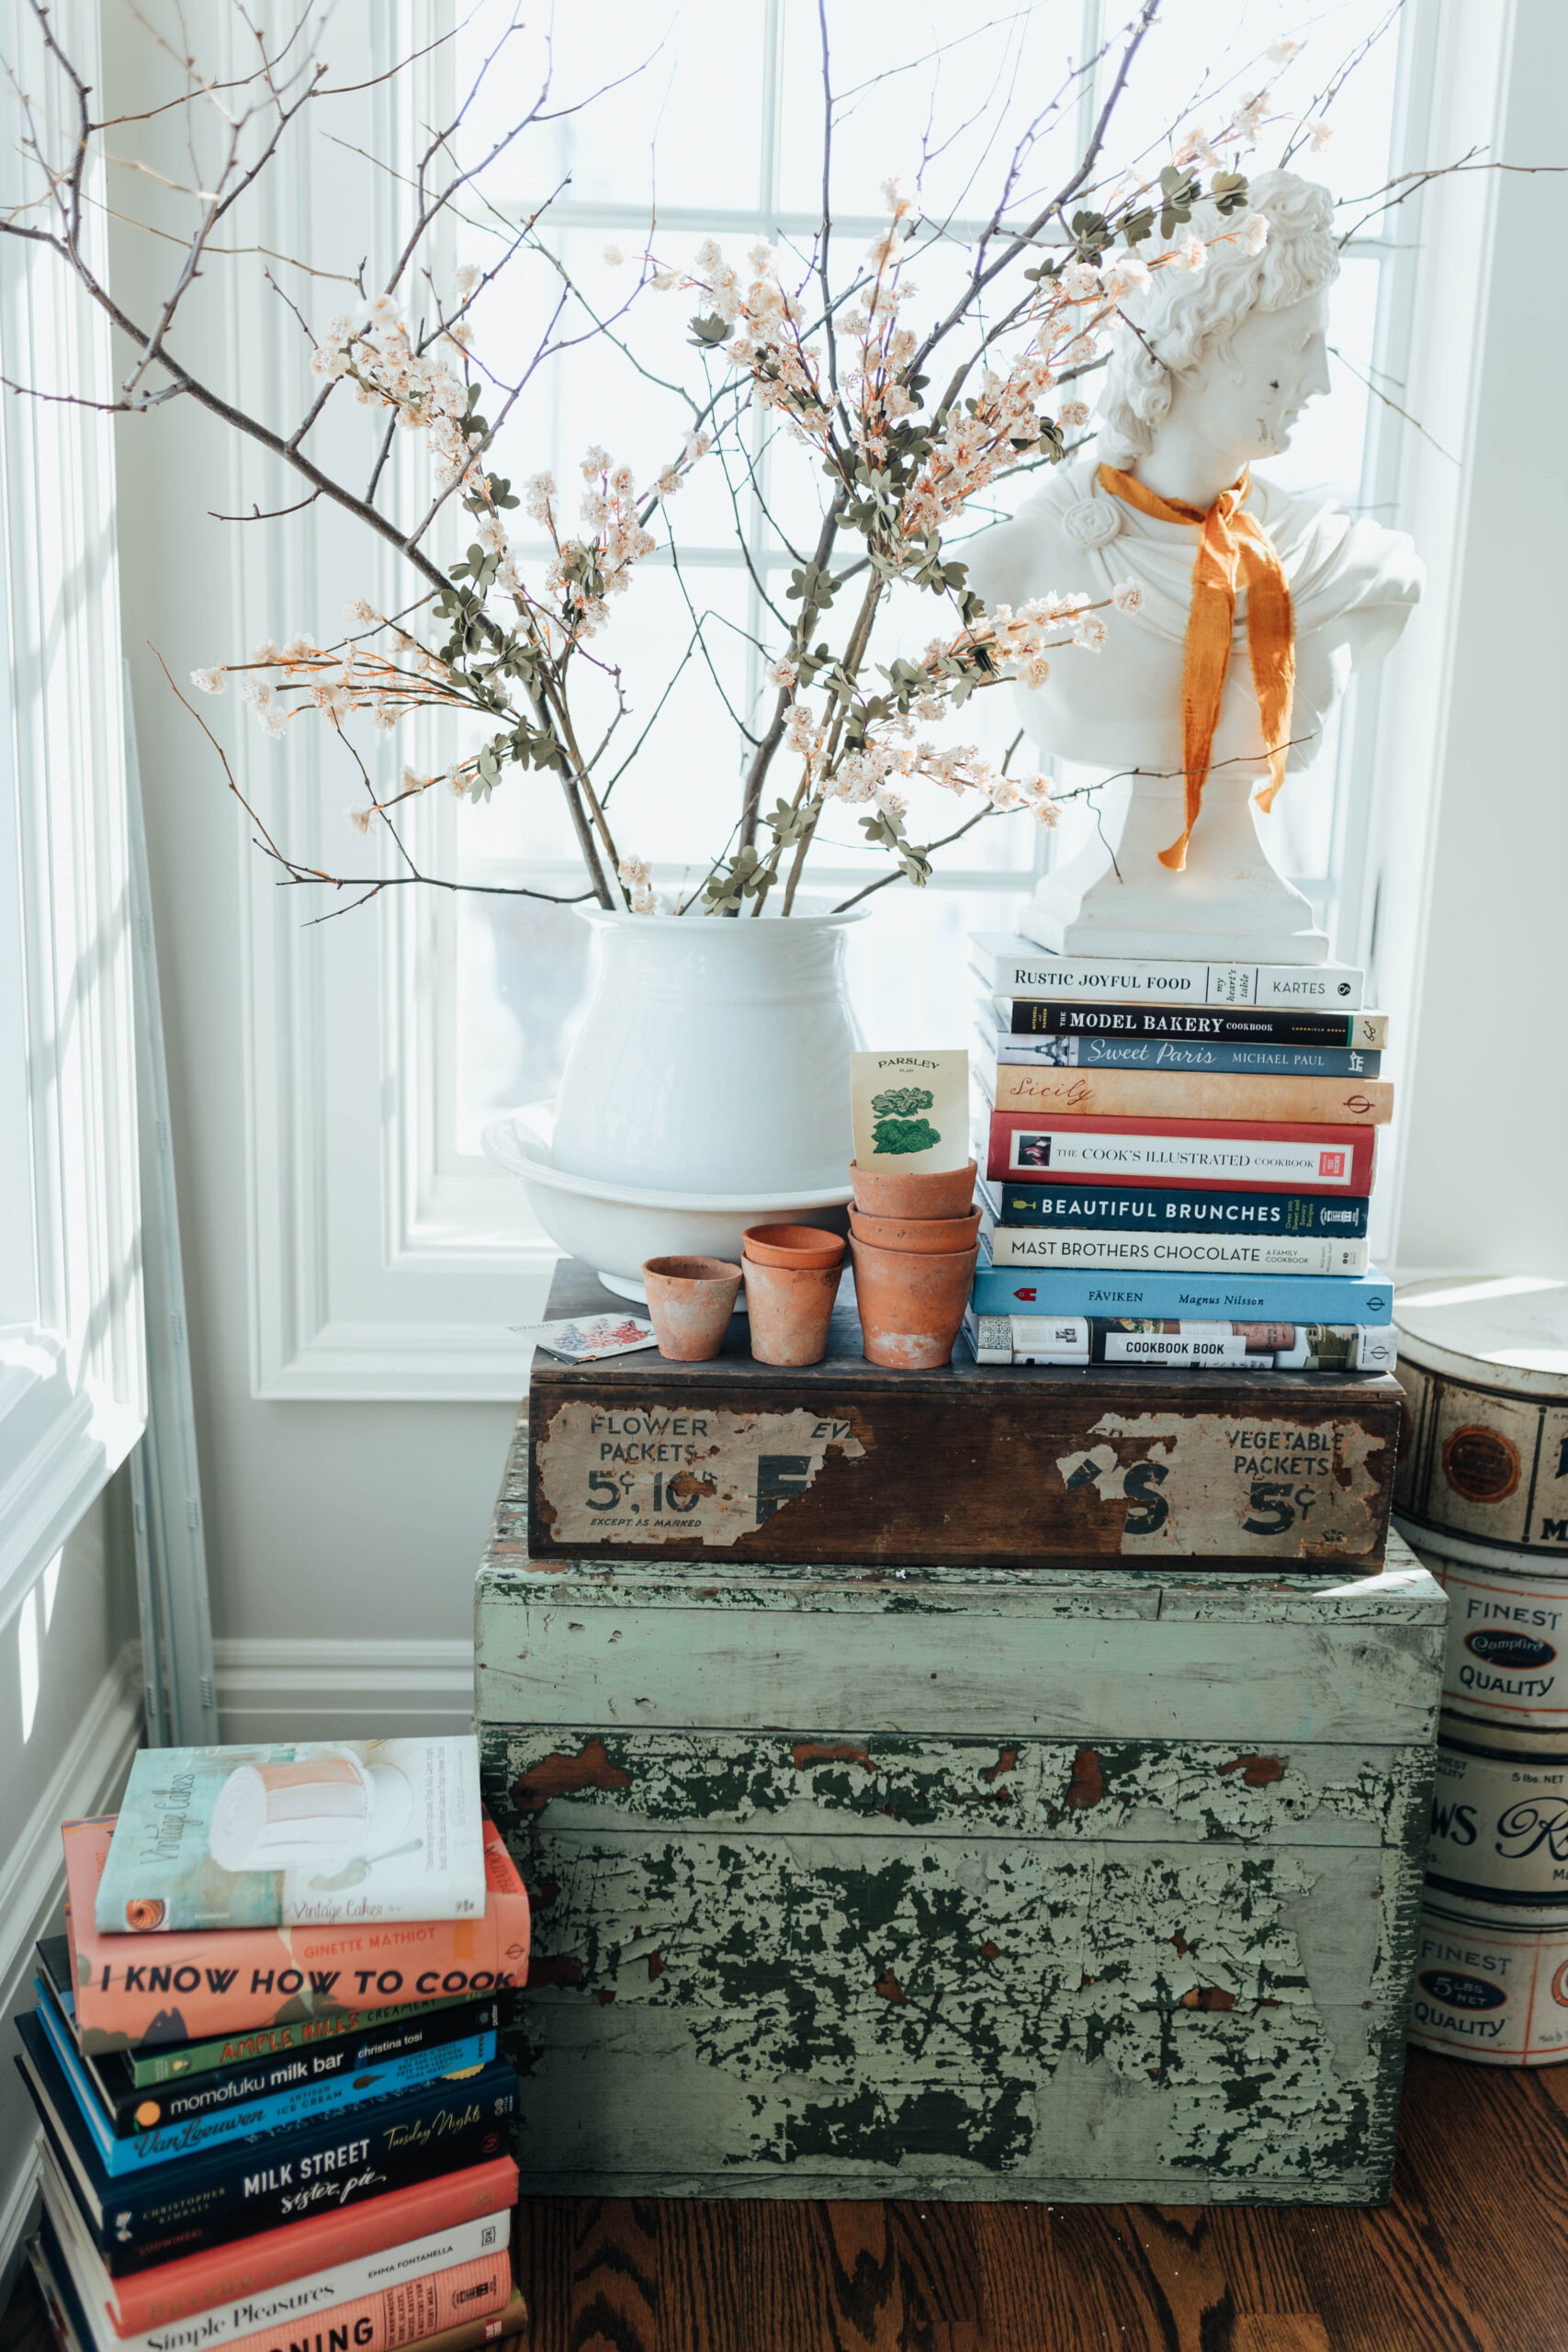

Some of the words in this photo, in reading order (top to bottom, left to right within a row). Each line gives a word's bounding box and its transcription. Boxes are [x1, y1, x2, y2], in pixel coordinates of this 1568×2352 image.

[1014, 969, 1074, 986] RUSTIC
[1078, 974, 1141, 989] JOYFUL
[1147, 977, 1191, 990] FOOD
[1216, 978, 1226, 992] my
[1226, 969, 1236, 1001] heart's
[1240, 974, 1249, 998] table
[1273, 981, 1325, 994] KARTES
[1070, 1012, 1136, 1030] MODEL
[1143, 1015, 1224, 1034] BAKERY
[1226, 1022, 1273, 1032] COOKBOOK
[877, 1057, 941, 1069] PARSLEY
[1087, 1038, 1150, 1062] Sweet
[1156, 1042, 1217, 1065] Paris
[1232, 1052, 1290, 1065] MICHAEL
[1294, 1055, 1325, 1066] PAUL
[1010, 1076, 1096, 1106] Sicily
[1056, 1148, 1078, 1158] THE
[1081, 1148, 1142, 1162] COOK'S
[1145, 1150, 1250, 1167] ILLUSTRATED
[1254, 1158, 1315, 1169] COOKBOOK
[1042, 1199, 1156, 1217] BEAUTIFUL
[1165, 1203, 1281, 1222] BRUNCHES
[1011, 1241, 1057, 1255] MAST
[1061, 1242, 1149, 1258] BROTHERS
[1154, 1245, 1260, 1261] CHOCOLATE
[1266, 1256, 1309, 1264] COOKBOOK
[1089, 1290, 1144, 1302] FÄVIKEN
[1178, 1294, 1220, 1306] Magnus
[1224, 1295, 1264, 1306] Nilsson
[1125, 1341, 1189, 1354] COOKBOOK
[1193, 1343, 1225, 1355] BOOK
[591, 1416, 708, 1438] FLOWER
[600, 1442, 695, 1464] PACKETS
[1234, 1455, 1329, 1476] PACKETS
[1241, 1482, 1316, 1536] 5¢
[591, 1518, 632, 1527] EXCEPT
[637, 1519, 650, 1527] AS
[654, 1519, 703, 1528] MARKED
[1467, 1598, 1562, 1631] FINEST
[1472, 1635, 1545, 1653] Campfire
[1459, 1665, 1555, 1698] QUALITY
[1511, 1772, 1521, 1782] 5
[1543, 1774, 1564, 1784] NET
[152, 1772, 196, 1811] Cakes
[293, 1897, 343, 1924] Vintage
[345, 1896, 383, 1917] Cakes
[303, 1938, 363, 1960] GINETTE
[369, 1927, 436, 1950] MATHIOT
[1421, 1939, 1513, 1976] FINEST
[100, 1964, 111, 1992] I
[125, 1965, 240, 1995] KNOW
[250, 1968, 341, 1995] HOW
[354, 1970, 403, 1996] TO
[415, 1970, 517, 1995] COOK
[1433, 1977, 1451, 1996] 5
[1456, 1993, 1487, 2007] NET
[1413, 2001, 1507, 2039] QUALITY
[220, 2027, 293, 2064] AMPLE
[301, 2011, 360, 2043] HILLS
[357, 2038, 402, 2059] christina
[404, 2030, 423, 2045] tosi
[170, 2075, 265, 2116] momofuku
[270, 2061, 310, 2086] milk
[312, 2052, 345, 2074] bar
[276, 2105, 297, 2118] ICE
[301, 2090, 344, 2109] CREAM
[133, 2129, 180, 2159] Van
[175, 2108, 266, 2153] Leeuwen
[382, 2119, 432, 2151] Tuesday
[432, 2104, 481, 2137] Nights
[243, 2163, 294, 2199] MILK
[300, 2138, 370, 2180] STREET
[340, 2165, 387, 2205] pie
[485, 2230, 493, 2244] DK
[368, 2265, 395, 2279] EMMA
[397, 2245, 454, 2270] FONTANELLA
[147, 2317, 226, 2352] Simple
[234, 2283, 335, 2328] Pleasures
